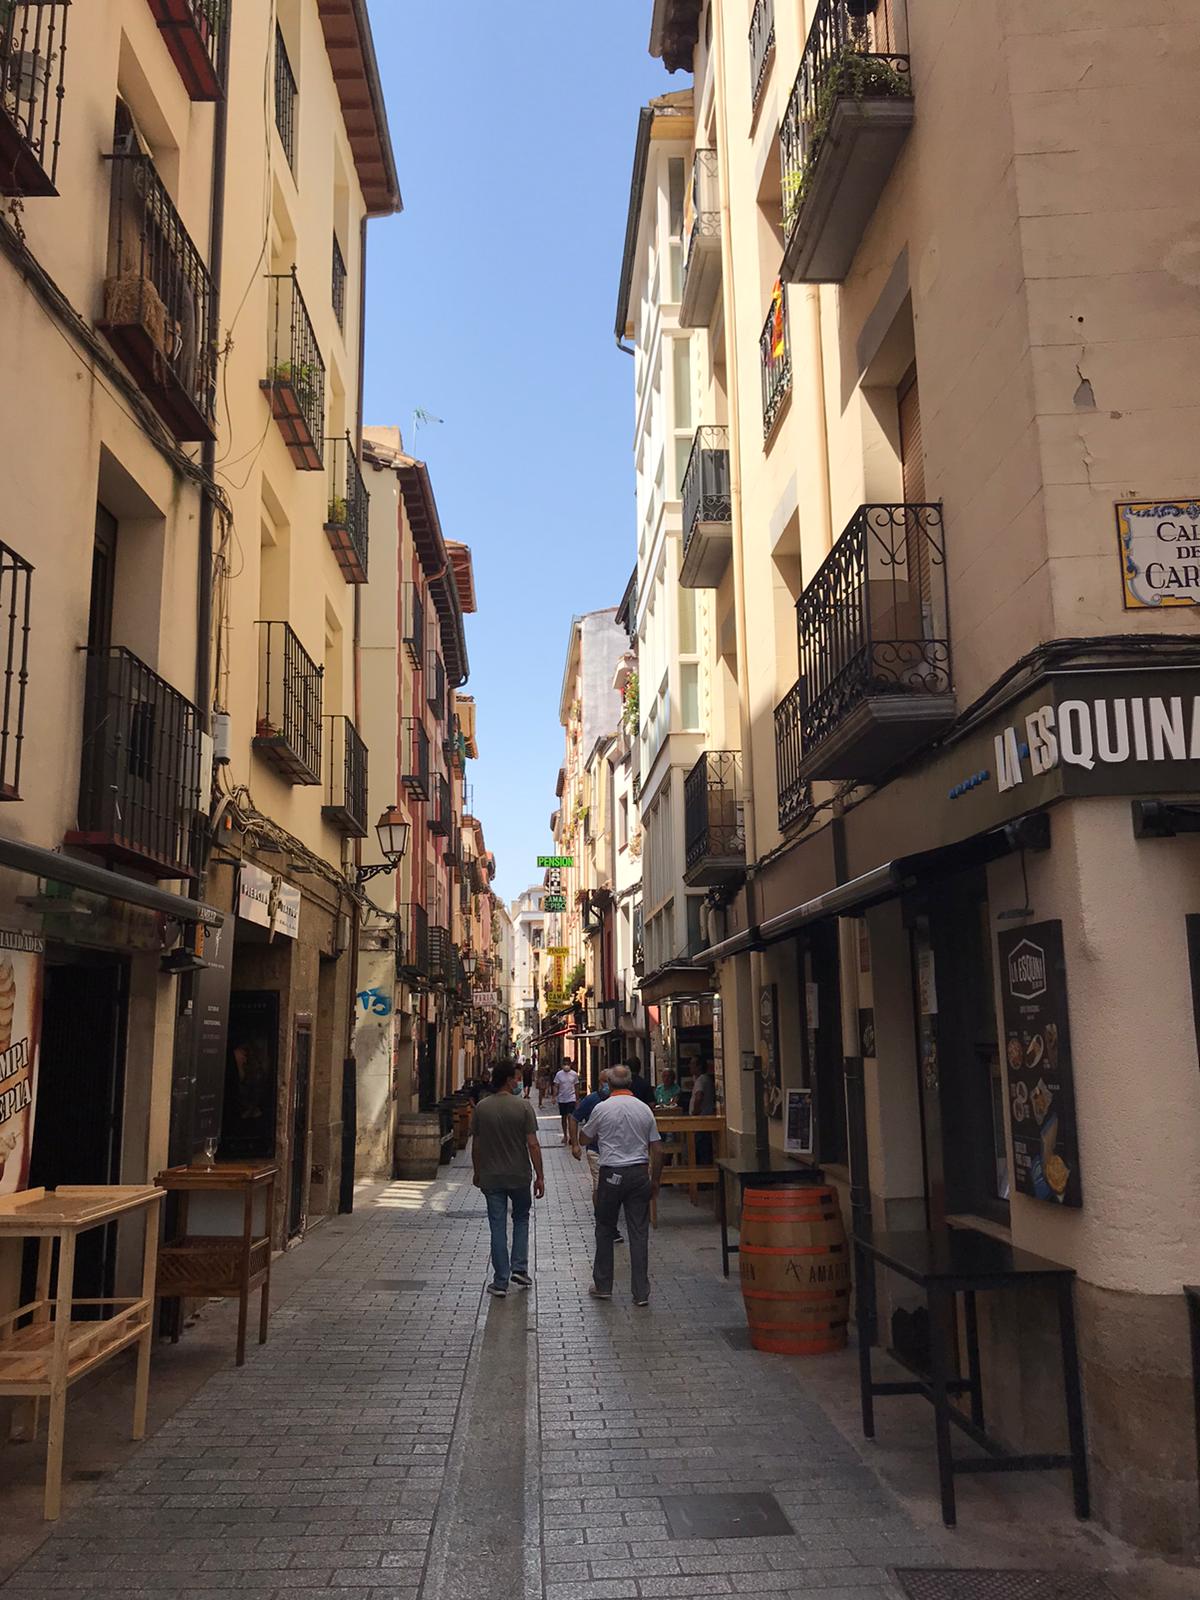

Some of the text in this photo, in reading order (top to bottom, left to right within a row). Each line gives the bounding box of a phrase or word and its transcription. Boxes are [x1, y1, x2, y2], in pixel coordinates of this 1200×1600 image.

[994, 696, 1200, 793] LA ESQUIN
[538, 857, 573, 867] PENSION
